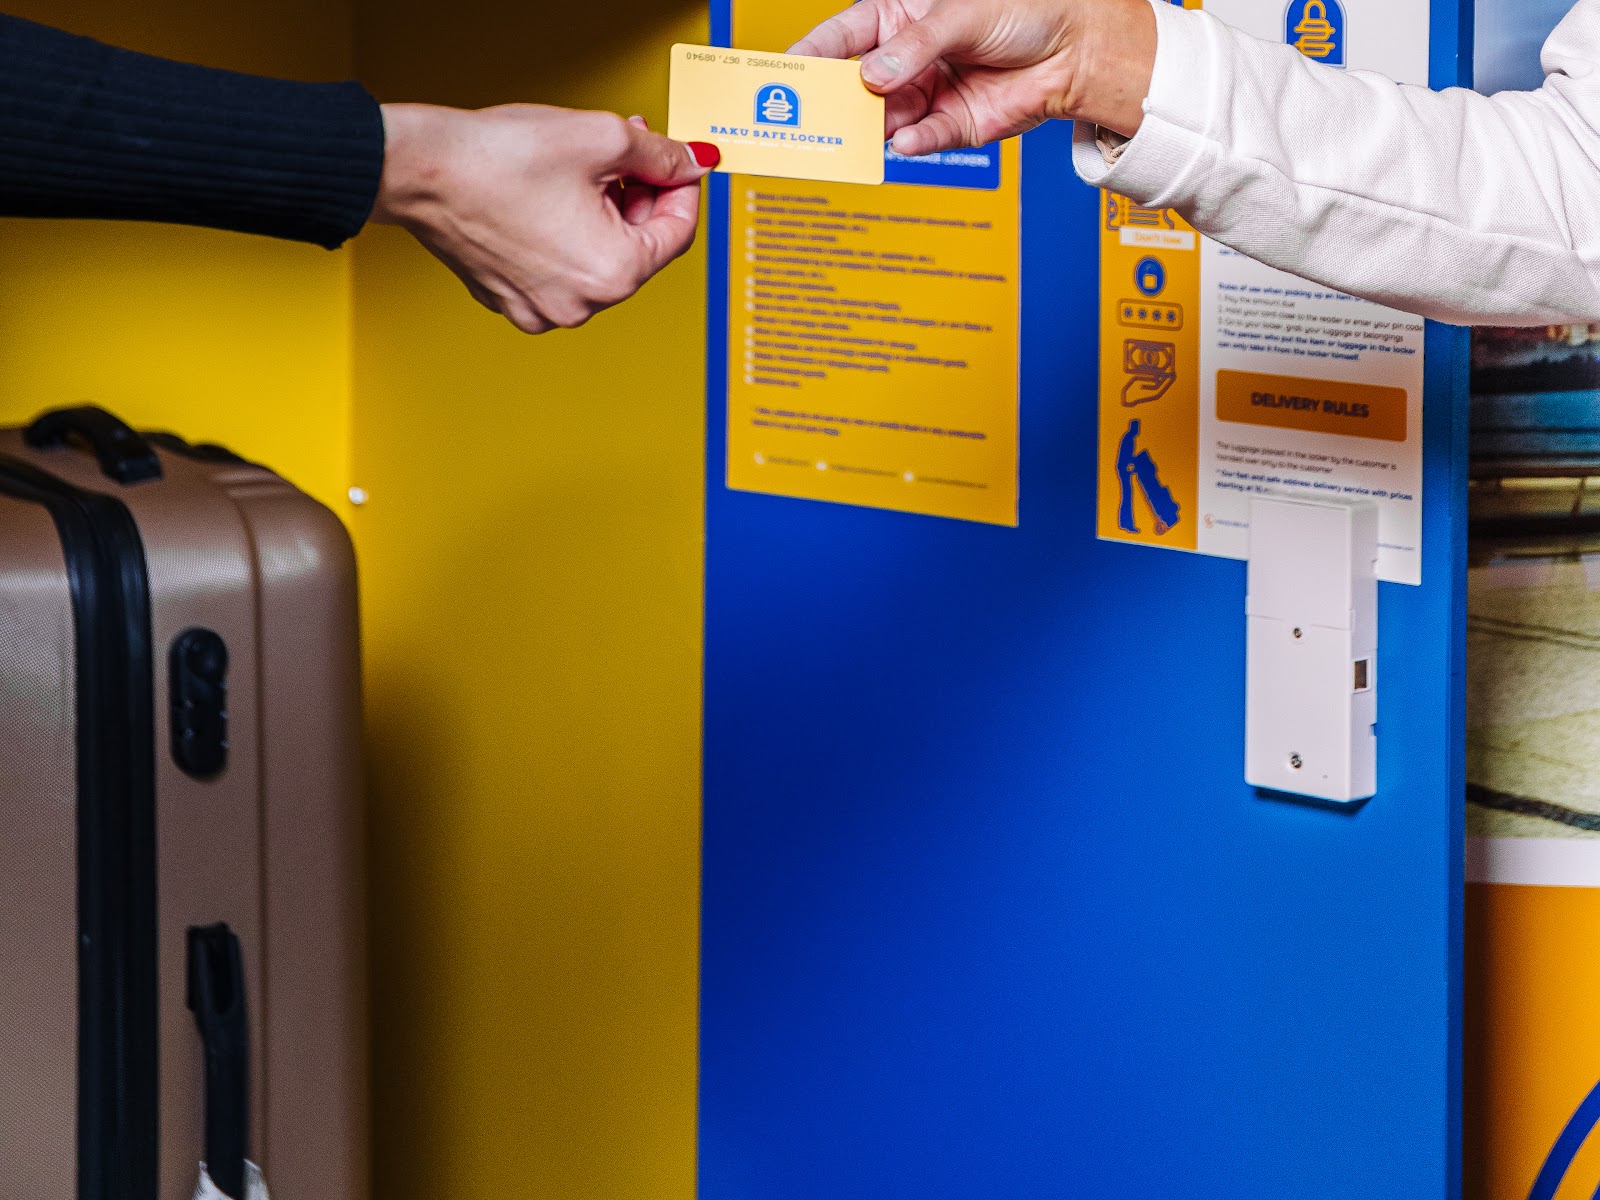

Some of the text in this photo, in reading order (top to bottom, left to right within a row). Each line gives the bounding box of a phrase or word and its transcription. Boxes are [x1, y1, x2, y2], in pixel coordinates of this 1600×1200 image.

[710, 125, 749, 137] BAKU
[753, 129, 787, 141] SAFE
[790, 132, 843, 146] LOCKER
[1251, 391, 1369, 418] DELIVERY RULES
